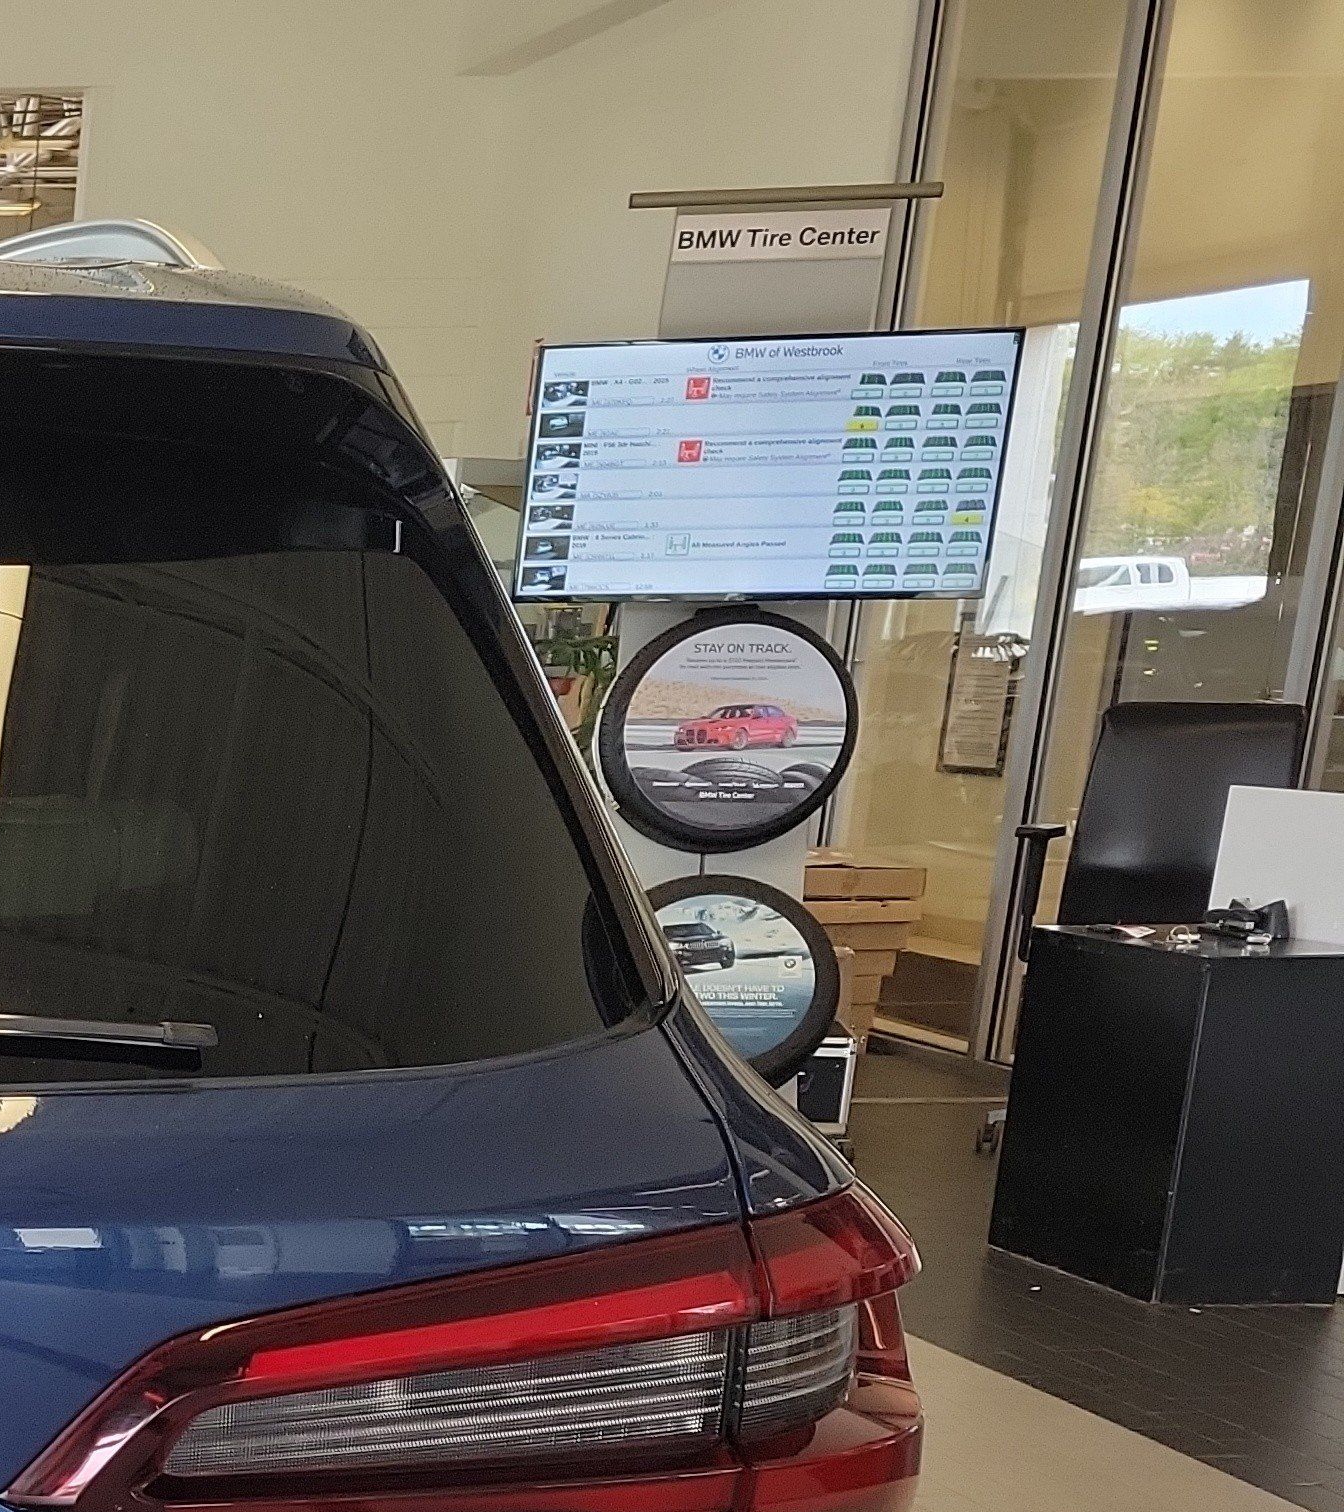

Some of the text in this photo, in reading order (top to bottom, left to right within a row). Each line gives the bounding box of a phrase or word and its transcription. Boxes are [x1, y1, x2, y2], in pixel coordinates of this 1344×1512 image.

[678, 226, 880, 249] BMW Tire Center
[735, 344, 844, 359] BMW of Westbrook
[694, 643, 792, 654] STAY ON TRACK.
[699, 791, 755, 799] BMW Tire Center
